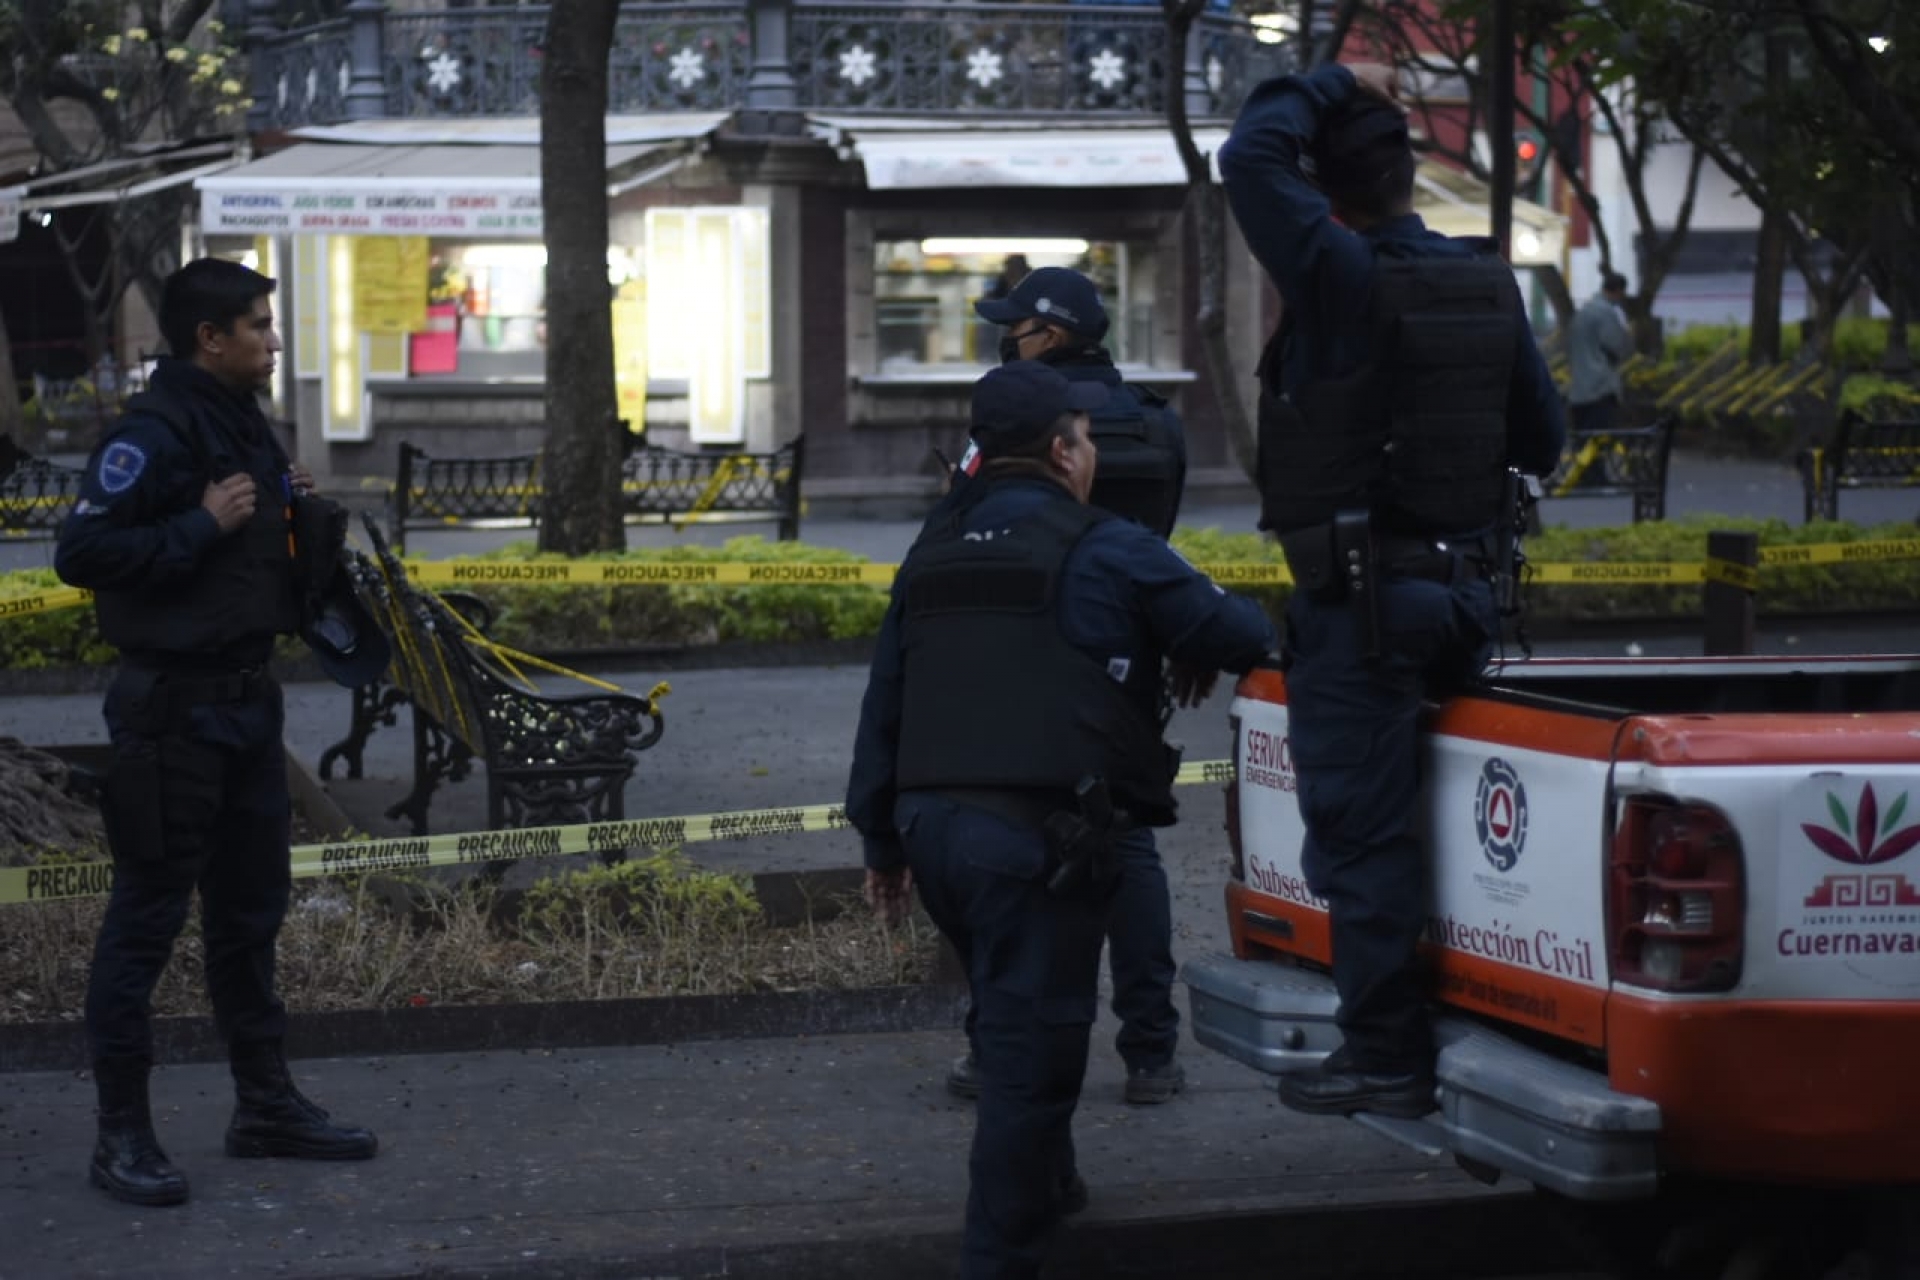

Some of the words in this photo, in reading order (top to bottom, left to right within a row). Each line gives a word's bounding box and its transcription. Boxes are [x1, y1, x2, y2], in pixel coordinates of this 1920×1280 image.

[321, 840, 430, 873] PRECAUCION
[458, 828, 561, 862] PRECAUCION
[588, 818, 687, 850] PRECAUCION
[710, 808, 804, 840] PRECAUCION
[1860, 915, 1920, 924] HAREMO
[1536, 929, 1594, 980] Civil
[1778, 928, 1920, 955] Cuernava
